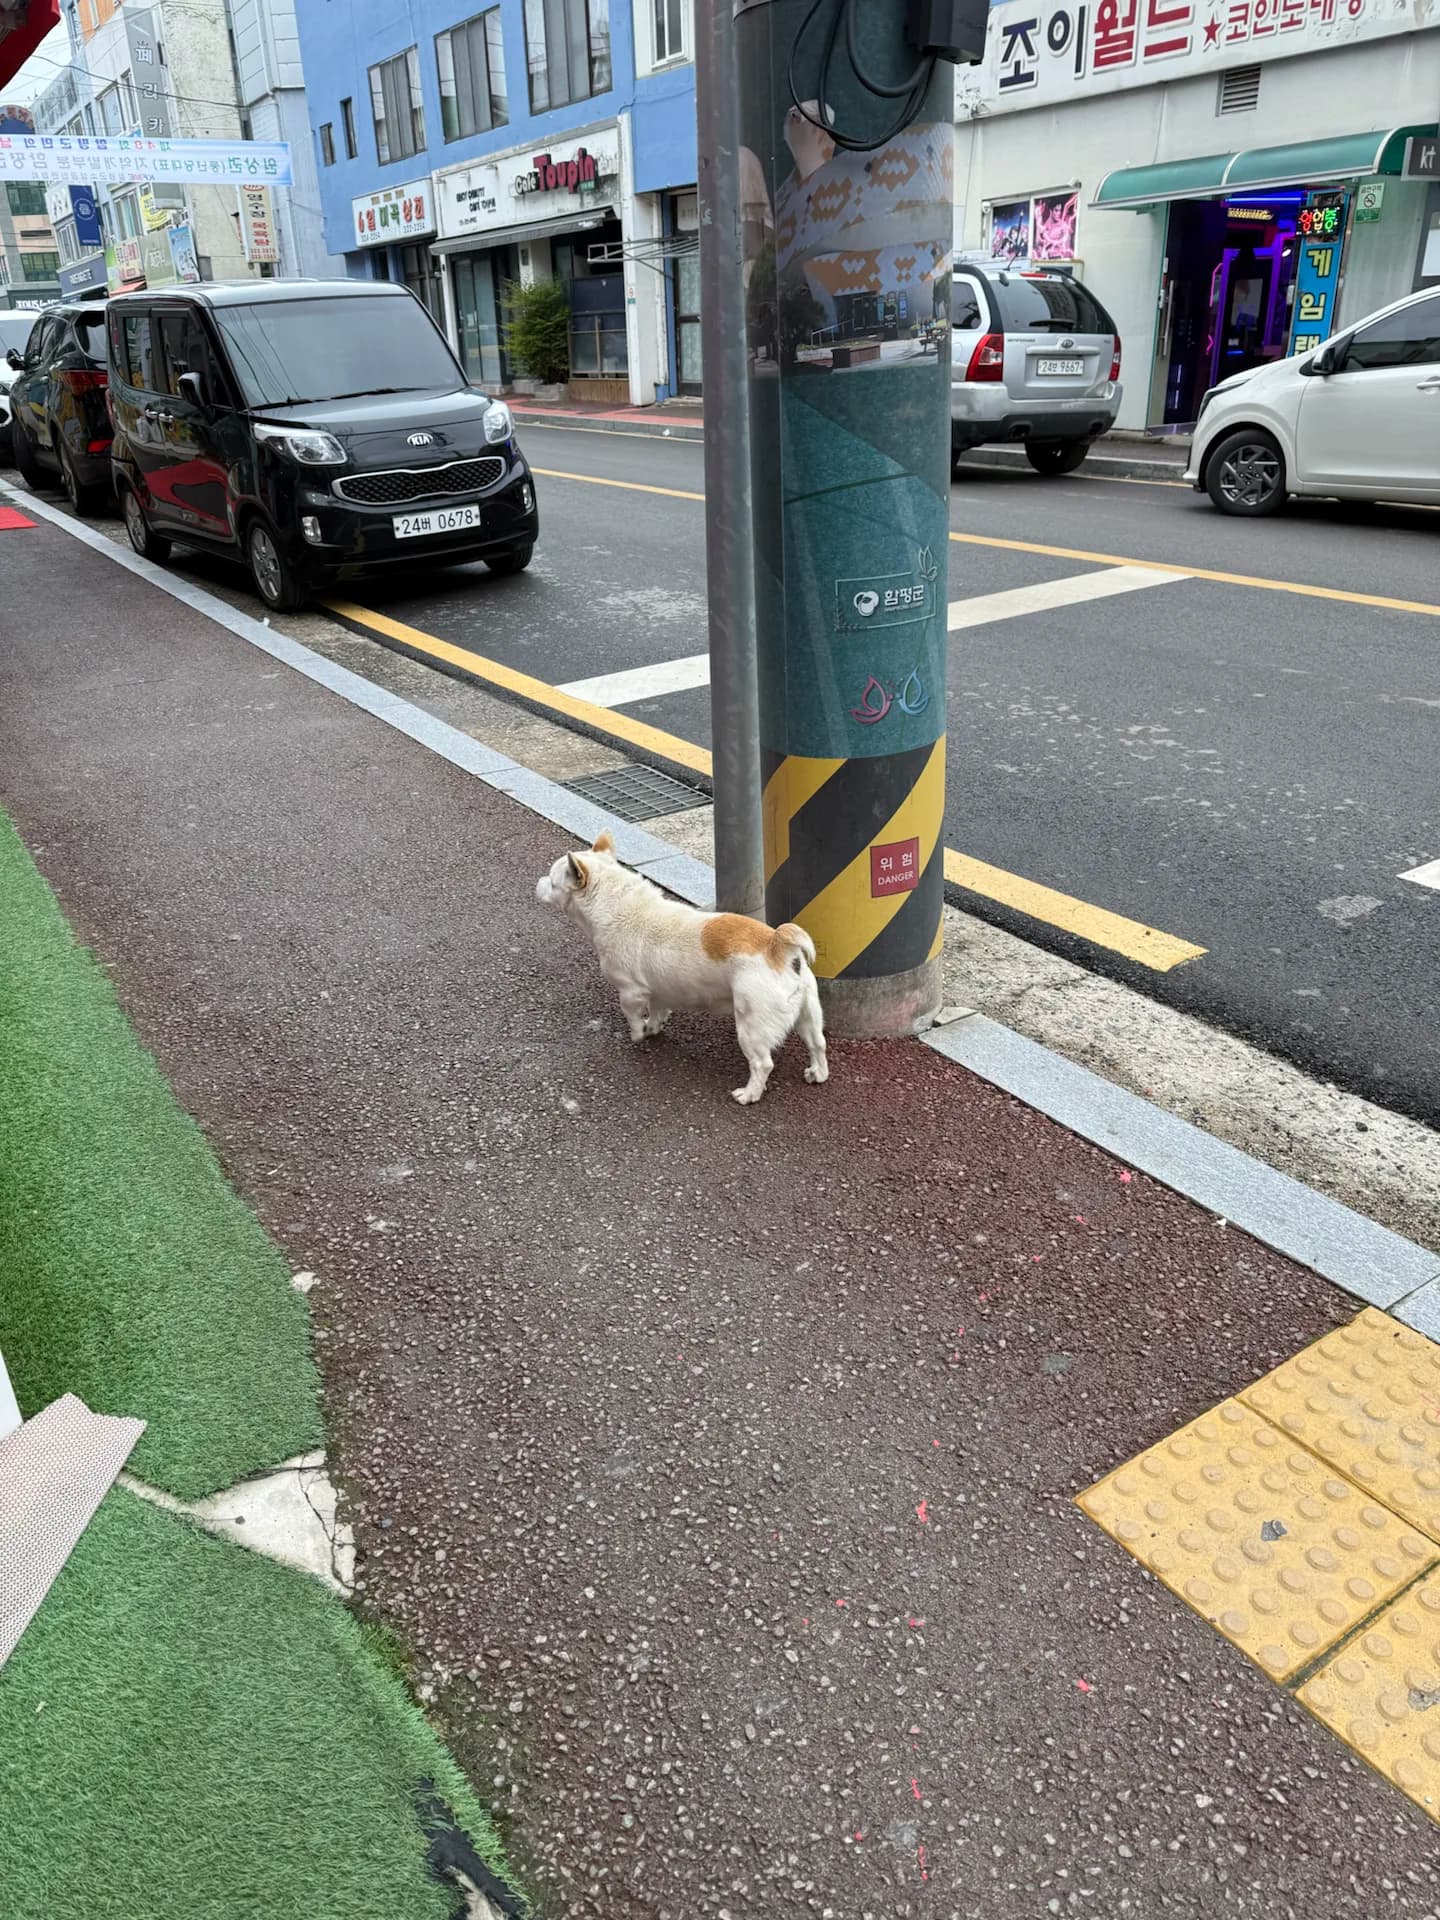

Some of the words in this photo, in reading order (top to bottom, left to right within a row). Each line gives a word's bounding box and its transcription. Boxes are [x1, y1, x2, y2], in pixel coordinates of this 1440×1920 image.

[1000, 0, 1190, 88] 조이월드
[1420, 145, 1436, 169] kt
[533, 147, 597, 194] Toupin
[411, 435, 431, 446] KIA
[401, 517, 431, 535] 24버
[438, 509, 473, 529] 0678
[884, 584, 925, 606] 함평군
[878, 870, 914, 886] DANGER
